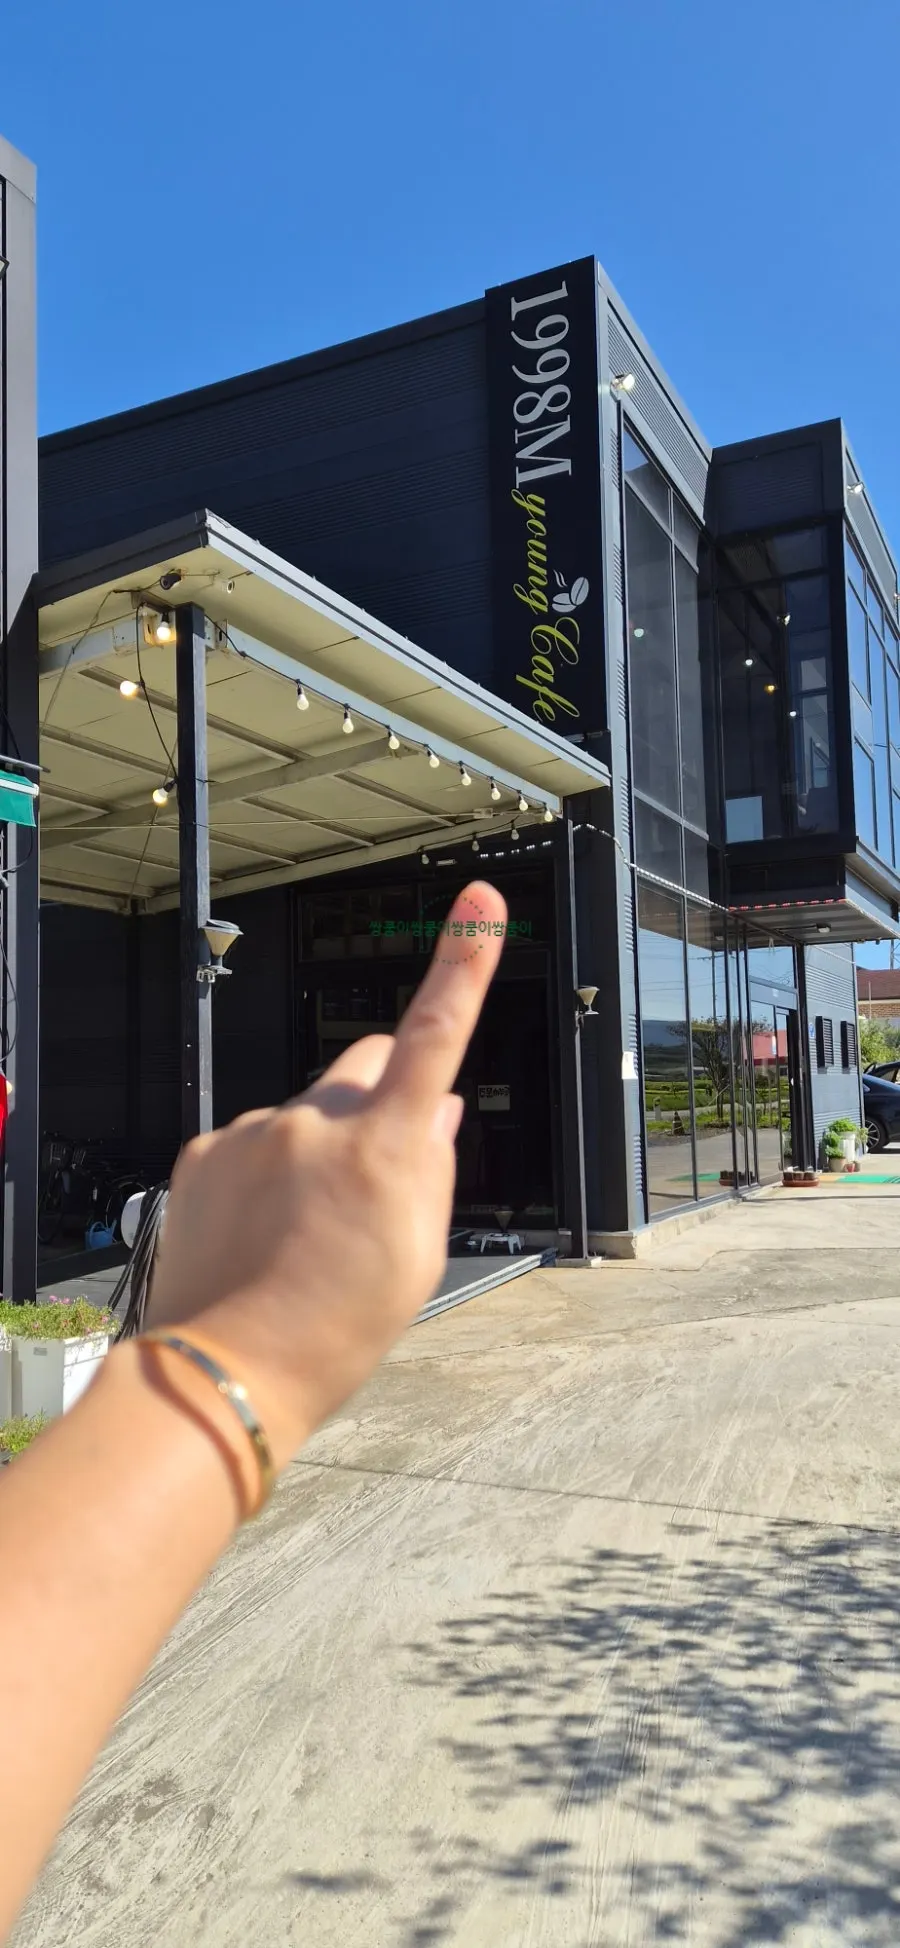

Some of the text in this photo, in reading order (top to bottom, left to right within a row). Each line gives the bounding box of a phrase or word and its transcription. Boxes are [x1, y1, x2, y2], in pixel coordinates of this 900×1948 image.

[510, 281, 580, 722] 1998M young Cafe
